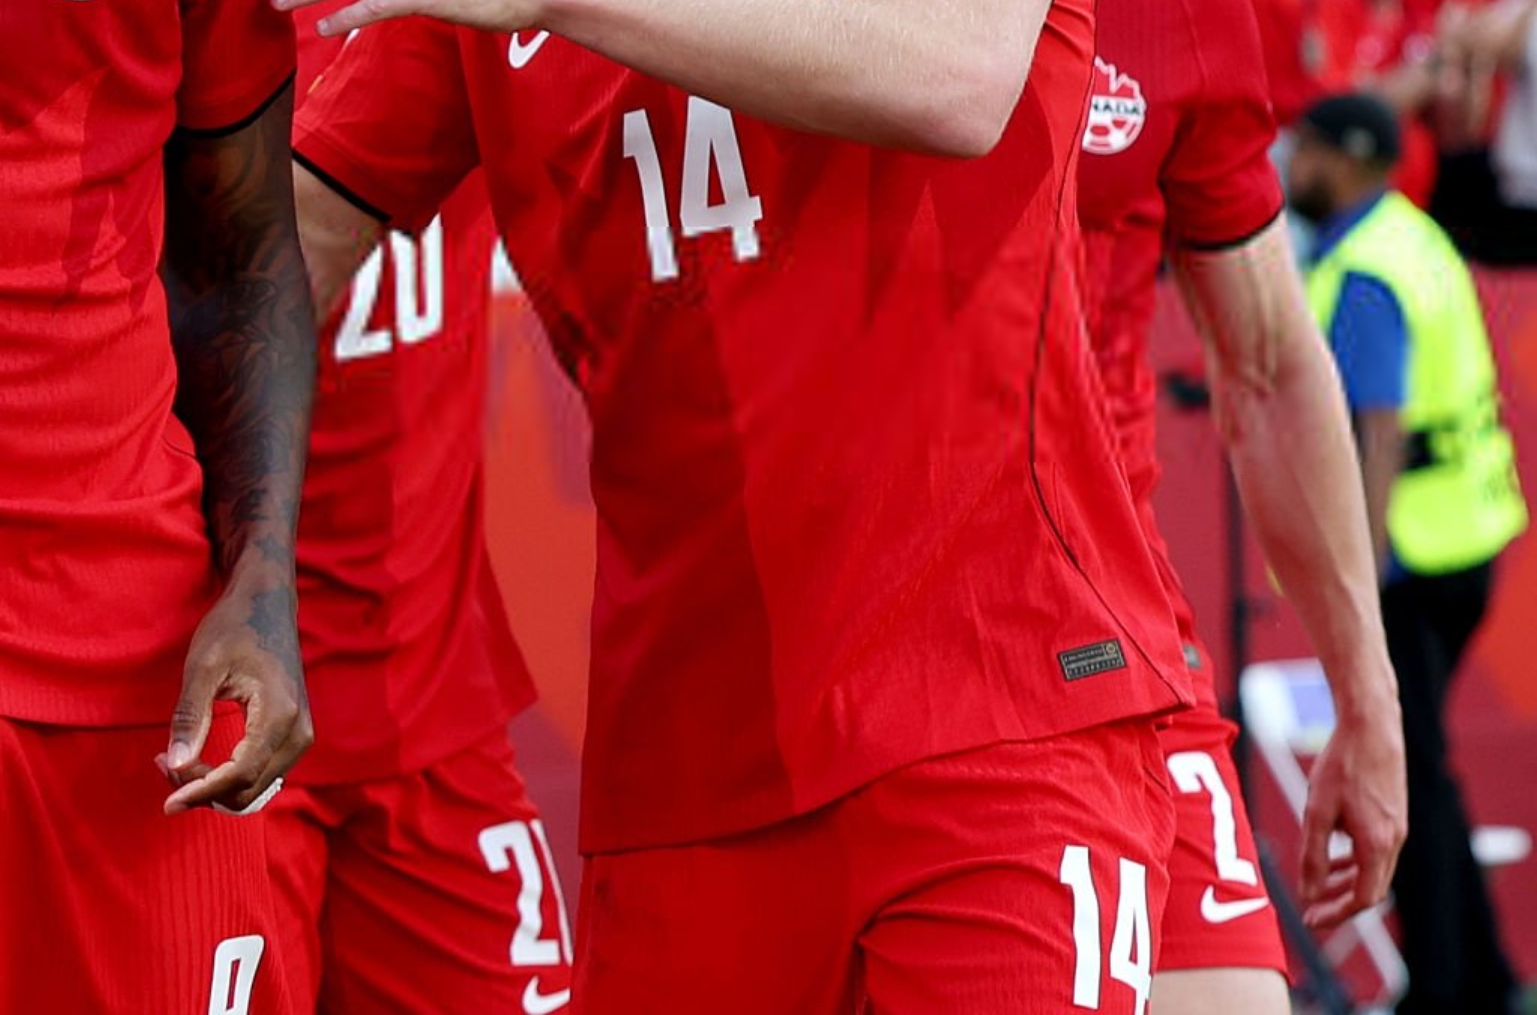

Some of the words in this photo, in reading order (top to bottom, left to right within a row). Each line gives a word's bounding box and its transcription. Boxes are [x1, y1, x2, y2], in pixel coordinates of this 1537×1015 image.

[622, 95, 763, 282] 14
[335, 211, 443, 362] 20
[478, 818, 573, 967] 2
[1166, 751, 1258, 885] 2
[1059, 844, 1152, 1015] 14
